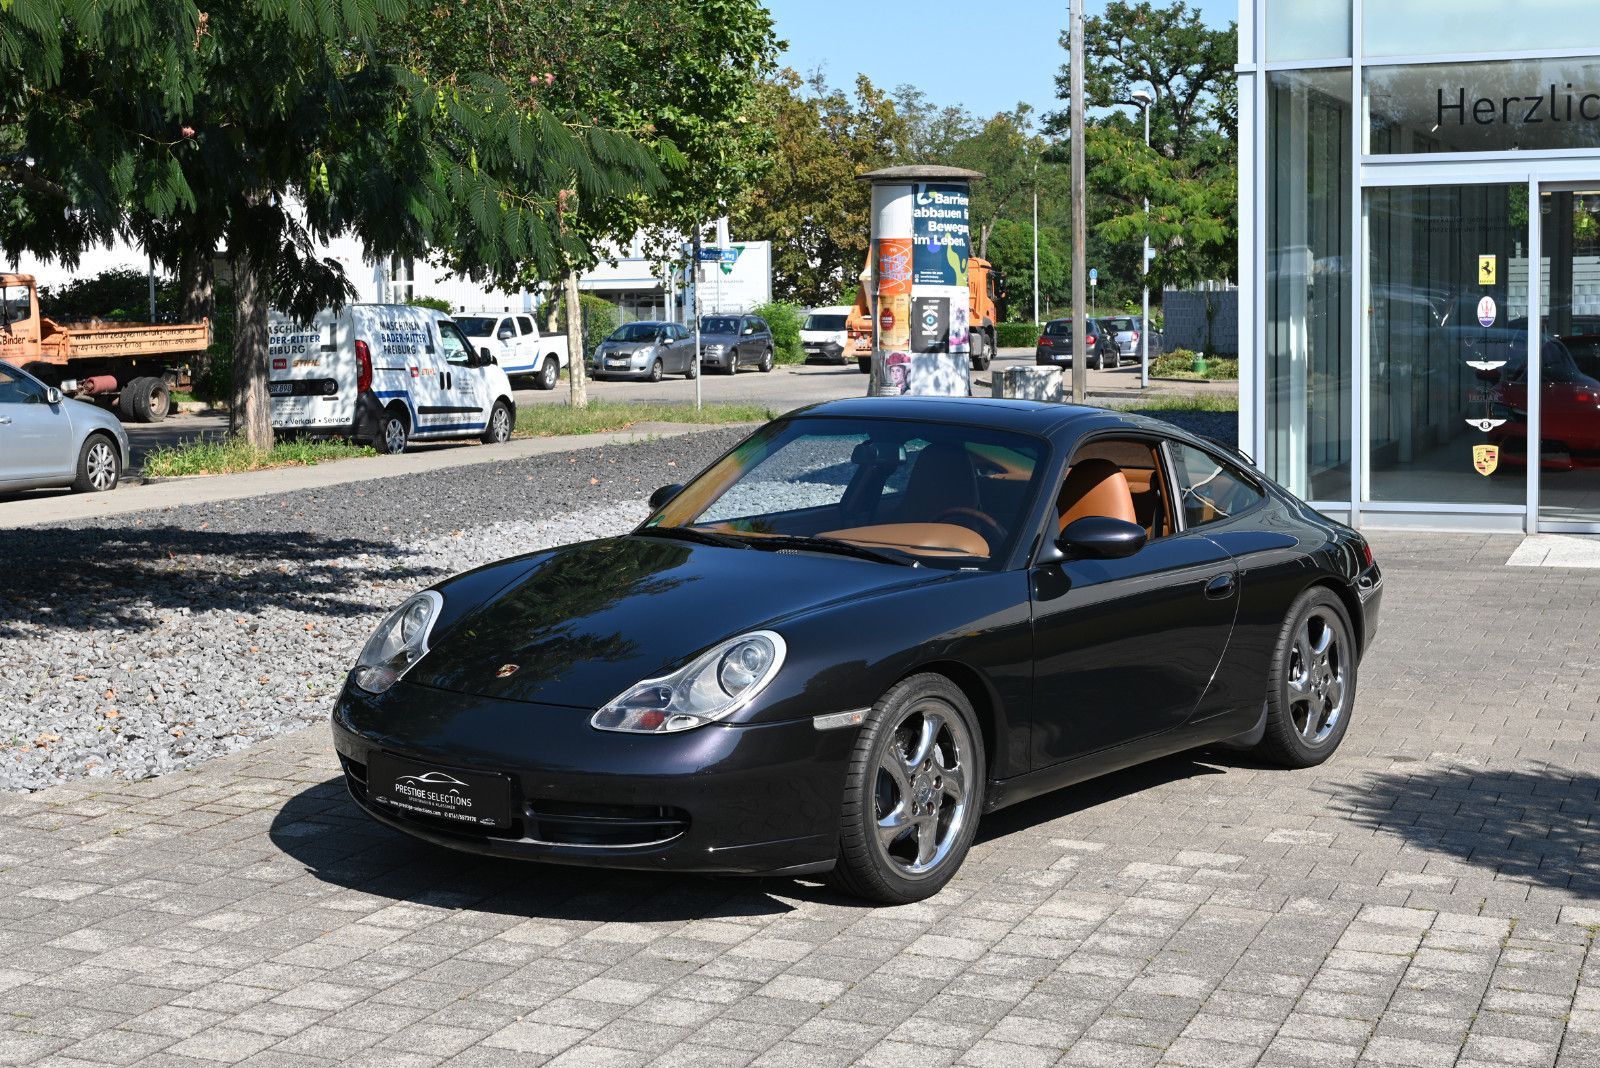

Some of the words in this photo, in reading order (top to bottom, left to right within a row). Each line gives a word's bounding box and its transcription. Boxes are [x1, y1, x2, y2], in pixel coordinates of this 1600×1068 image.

[914, 207, 961, 219] abbauen
[914, 234, 930, 245] im
[934, 235, 965, 246] Leben.
[380, 321, 420, 331] MASCHINEN
[3, 335, 26, 346] Binder
[270, 335, 321, 345] DER-RITTER
[381, 333, 427, 343] BADER-RITTER
[270, 345, 306, 355] EIBURG
[383, 345, 417, 355] FREIBURG
[290, 417, 316, 425] Verkauf
[323, 416, 351, 424] Service
[395, 783, 426, 799] PRESTIGE
[427, 791, 472, 807] SELECTIONS
